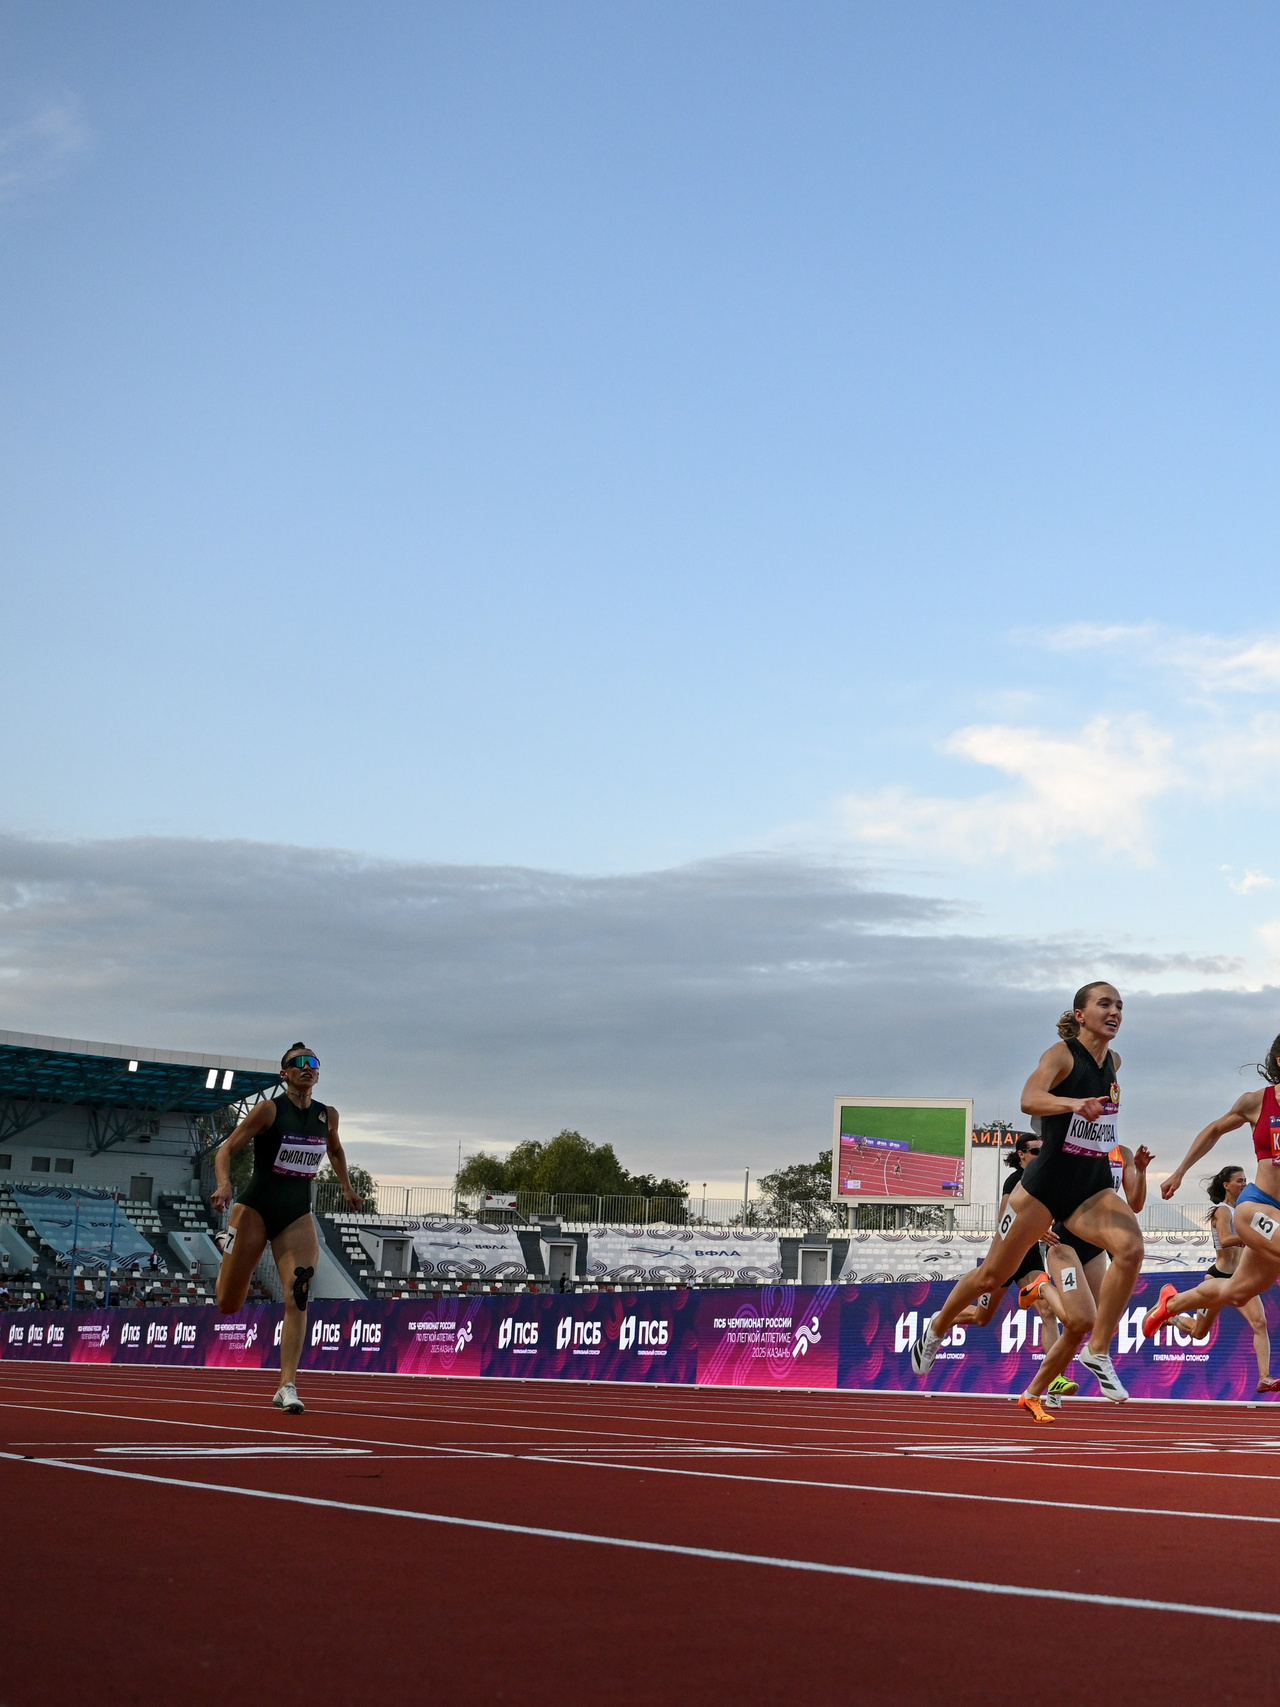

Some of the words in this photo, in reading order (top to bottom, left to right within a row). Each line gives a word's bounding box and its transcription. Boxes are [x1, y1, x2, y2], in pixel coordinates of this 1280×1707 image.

[280, 1149, 322, 1166] ФИЛАТОВА
[1001, 1214, 1012, 1234] 6
[1256, 1217, 1274, 1234] 5
[226, 1233, 235, 1249] 7
[1064, 1272, 1075, 1287] 4
[981, 1294, 989, 1306] 3
[714, 1318, 726, 1328] ПСБ
[727, 1318, 764, 1328] ЧЕМПИОНАТ
[765, 1318, 792, 1328] РОССИИ
[322, 1324, 340, 1342] ПСБ
[362, 1323, 381, 1343] ПСБ
[514, 1322, 539, 1345] ПСБ
[574, 1321, 601, 1345] ПСБ
[638, 1320, 669, 1345] ПСБ
[727, 1332, 736, 1342] ПО
[737, 1330, 760, 1342] ЛЕГКОЙ
[761, 1332, 792, 1342] АТЛЕТИКЕ
[752, 1348, 766, 1358] 2025
[767, 1348, 790, 1358] КАЗАНЬ
[1153, 1353, 1185, 1361] ГЕНЕРАЛЬНЫЙ
